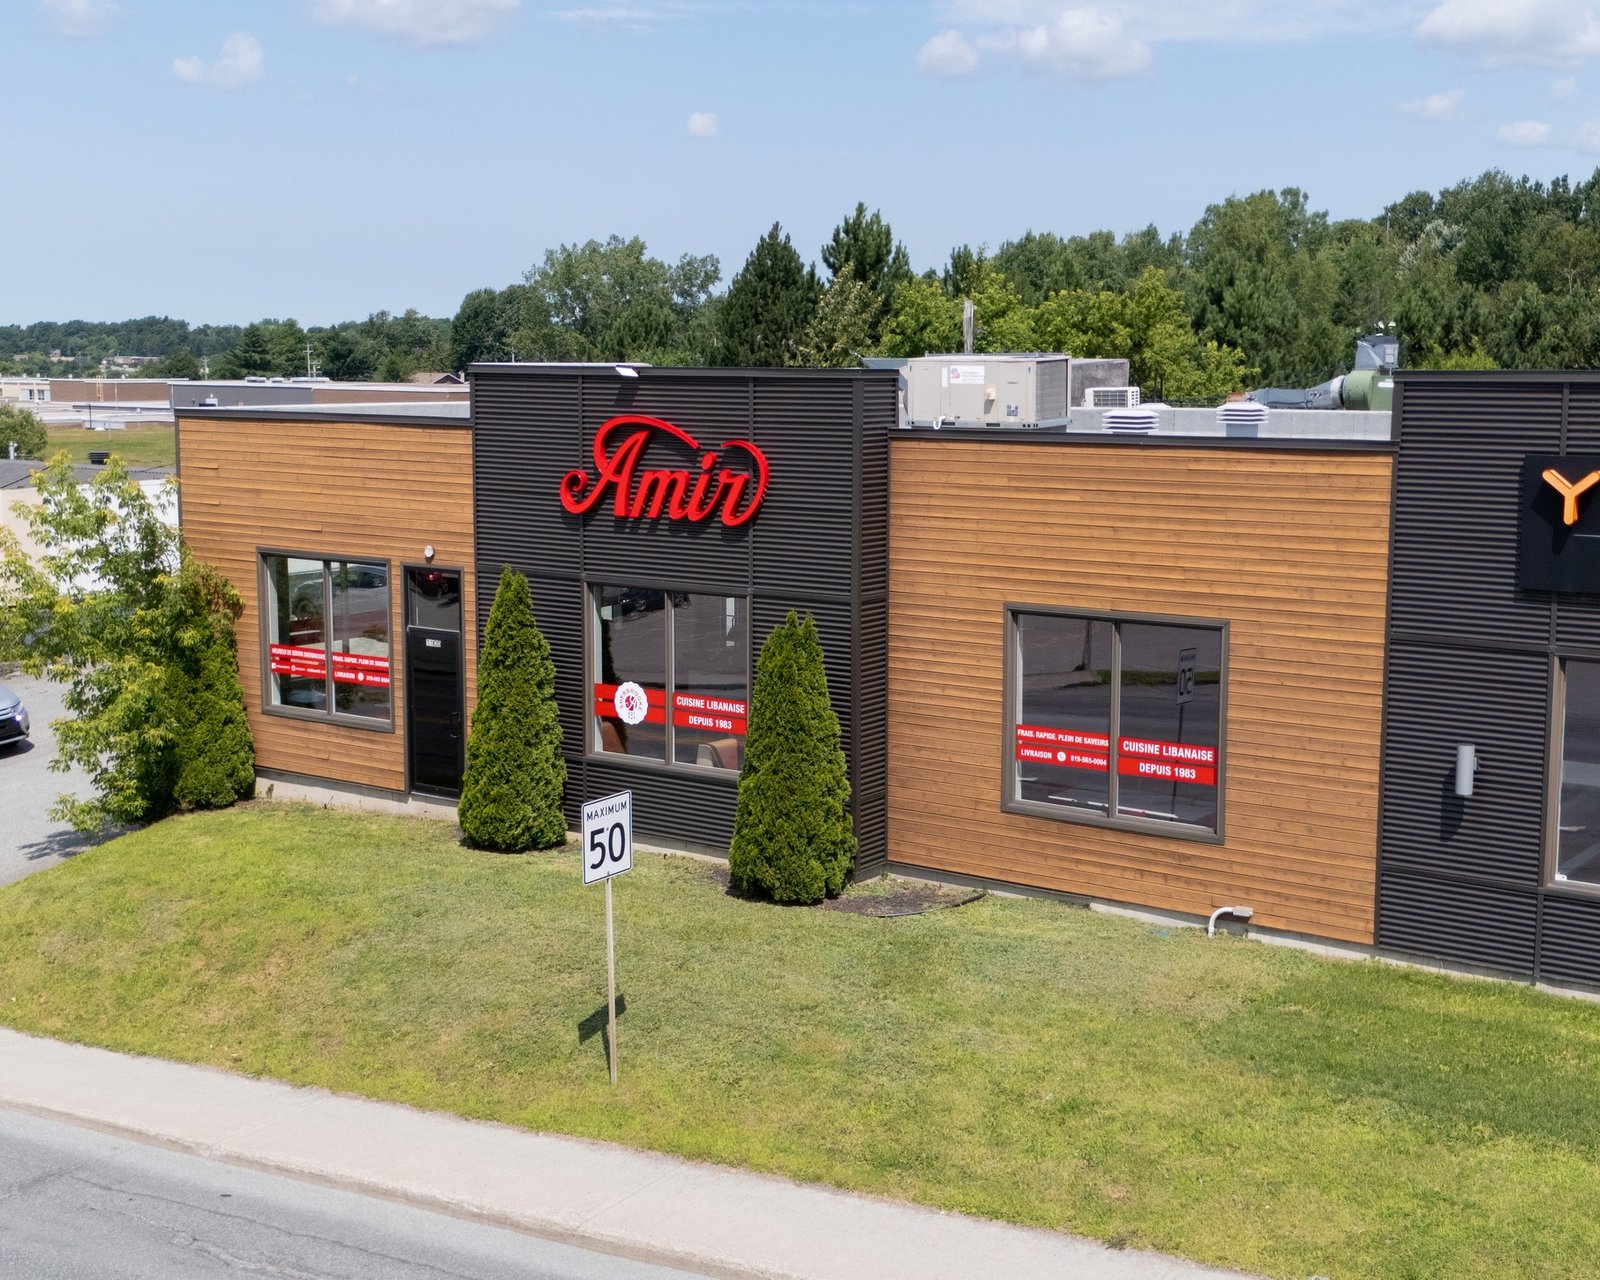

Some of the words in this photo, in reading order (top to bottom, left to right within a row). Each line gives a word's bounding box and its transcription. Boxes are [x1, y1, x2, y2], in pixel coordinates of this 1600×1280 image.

[560, 414, 769, 526] Amir
[1542, 469, 1600, 525] Y
[676, 696, 705, 709] CUISINE
[706, 702, 745, 714] LIBANAISE
[688, 715, 714, 727] DEPUIS
[715, 718, 732, 729] 1983
[1058, 734, 1075, 742] PLEIN
[1083, 738, 1109, 747] SAVEURS
[1021, 749, 1052, 759] LIVRAISON
[1123, 741, 1160, 755] CUISINE
[1162, 746, 1214, 761] LIBANAISE
[1139, 763, 1172, 776] DEPUIS
[1174, 767, 1196, 779] 1983
[586, 801, 627, 821] MAXIMUM
[590, 822, 625, 870] 50
